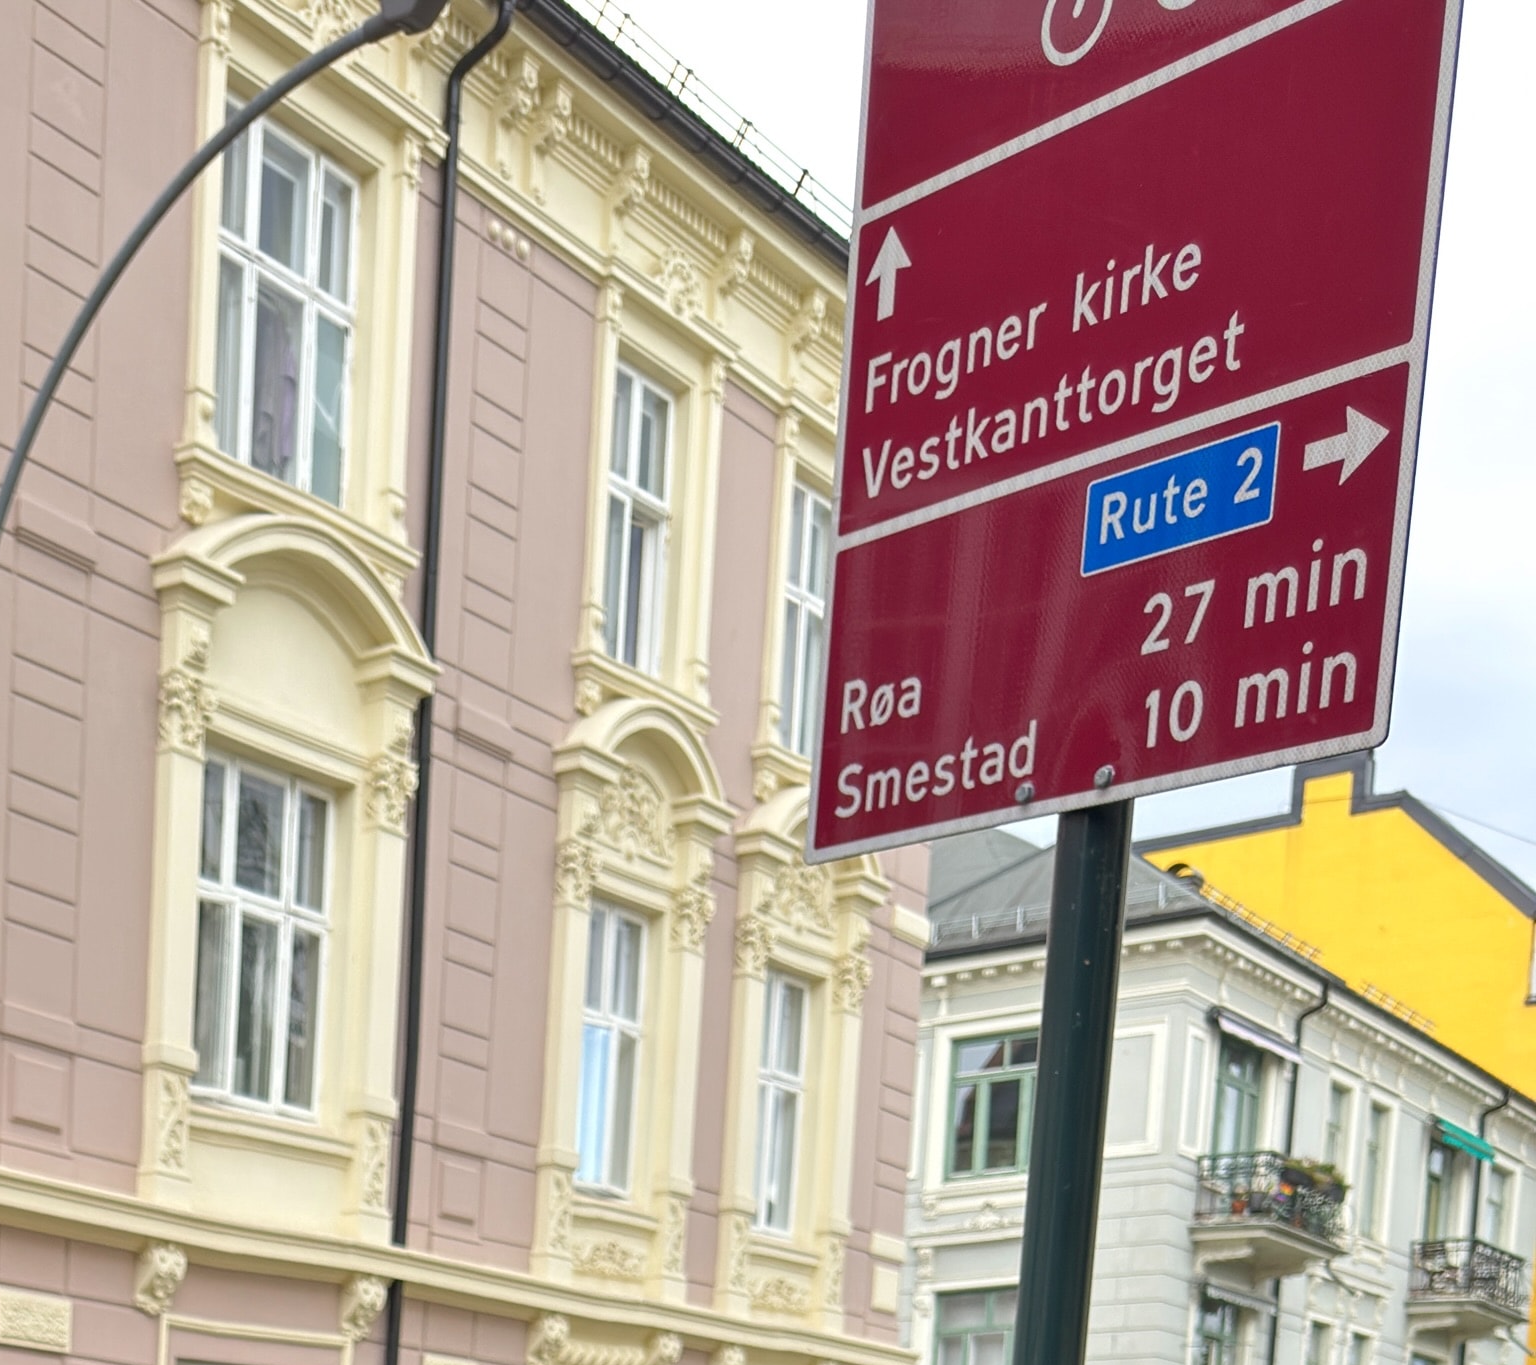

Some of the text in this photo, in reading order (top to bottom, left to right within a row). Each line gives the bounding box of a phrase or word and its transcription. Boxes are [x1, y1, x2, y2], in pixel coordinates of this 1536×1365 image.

[862, 310, 1246, 499] Vestkanttorget
[864, 242, 1202, 414] Frogner kirke
[1099, 446, 1264, 545] Rute 2
[840, 538, 1368, 734] Røa 27 min
[834, 641, 1357, 819] Smestad 10 min
